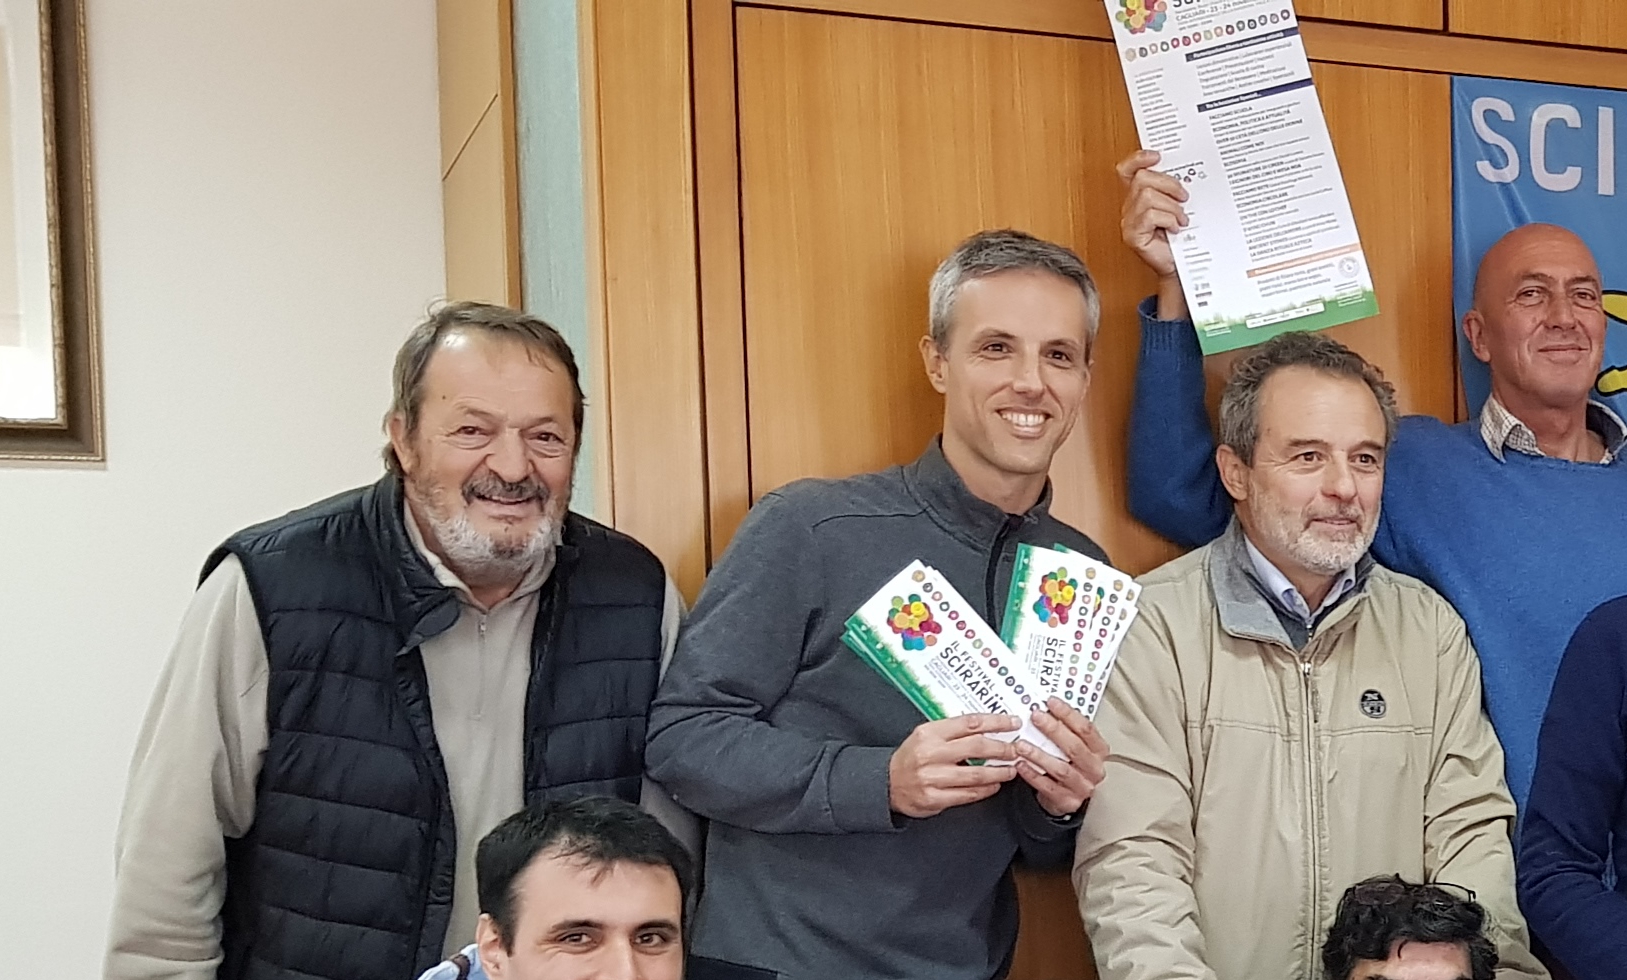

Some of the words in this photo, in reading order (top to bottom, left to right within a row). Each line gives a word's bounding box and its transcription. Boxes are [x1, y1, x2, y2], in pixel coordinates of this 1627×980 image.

[940, 647, 1008, 714] SCIRARIN
[960, 651, 995, 691] FESTIVAL
[1051, 653, 1064, 693] FESTIVA
